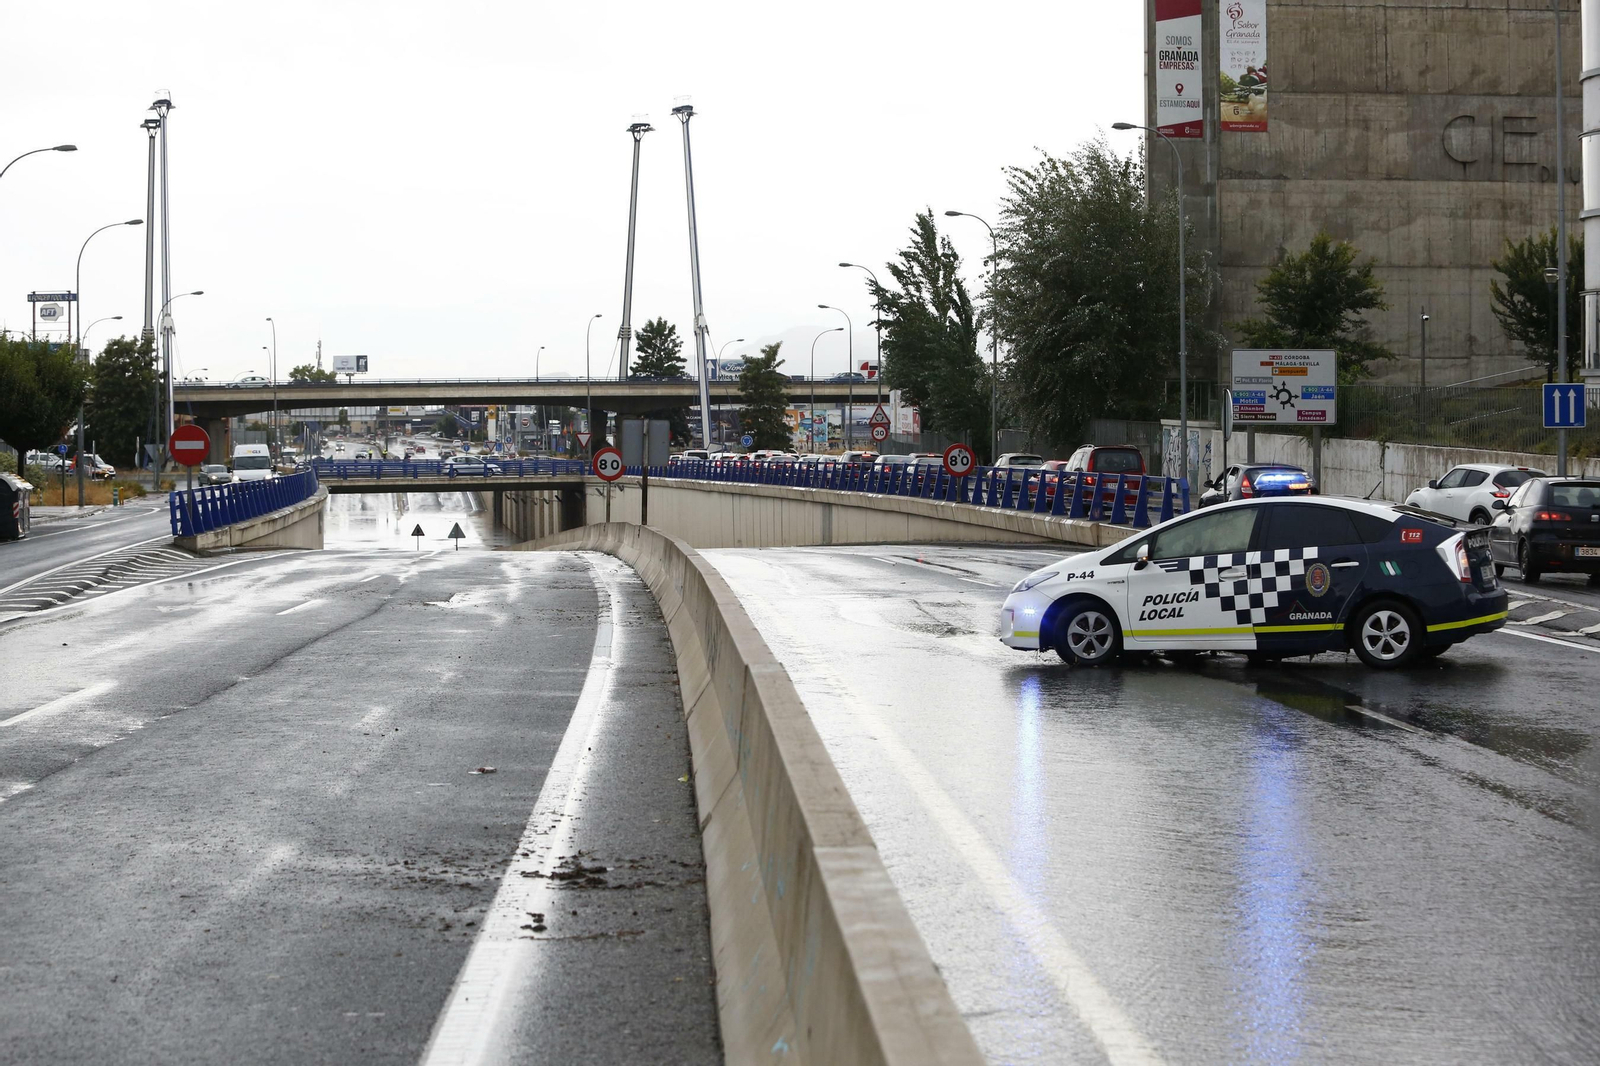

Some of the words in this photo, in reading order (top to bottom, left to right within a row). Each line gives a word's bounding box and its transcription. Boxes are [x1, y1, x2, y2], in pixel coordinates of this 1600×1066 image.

[1237, 21, 1259, 29] Sabor
[1226, 29, 1260, 38] Granada
[1165, 36, 1192, 46] SOMOS
[1159, 50, 1199, 61] GRANADA
[1159, 61, 1194, 70] EMPRESAS
[725, 362, 747, 371] Ford
[599, 459, 619, 470] 80
[950, 455, 969, 466] 80
[1067, 571, 1095, 581] P-44
[1142, 588, 1199, 606] POLICÍA
[1139, 607, 1184, 621] LOCAL
[1289, 612, 1332, 620] GRANADA
